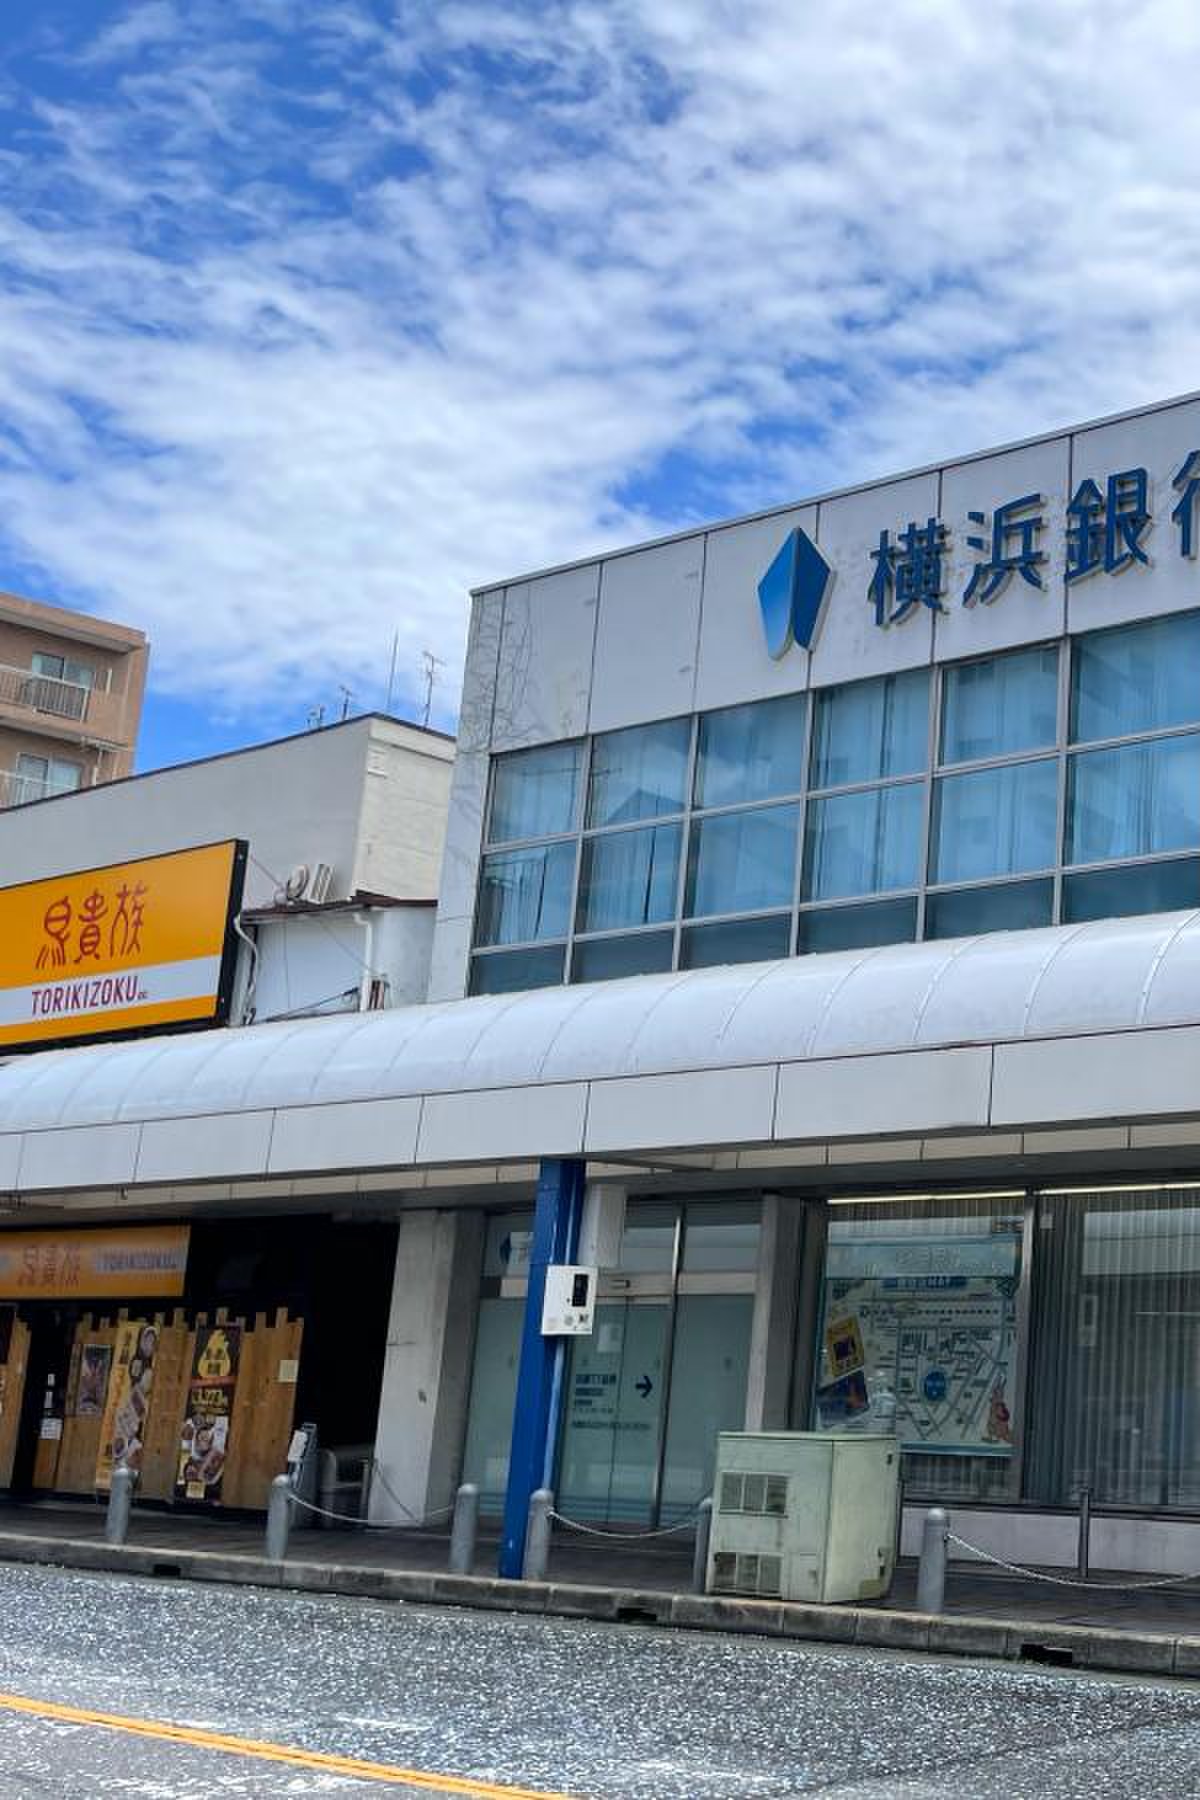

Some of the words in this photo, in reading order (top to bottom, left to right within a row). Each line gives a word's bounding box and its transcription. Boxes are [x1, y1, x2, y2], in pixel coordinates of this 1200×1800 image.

[35, 881, 149, 970] 鳥貴族
[32, 976, 138, 1016] TORIKIZOKU
